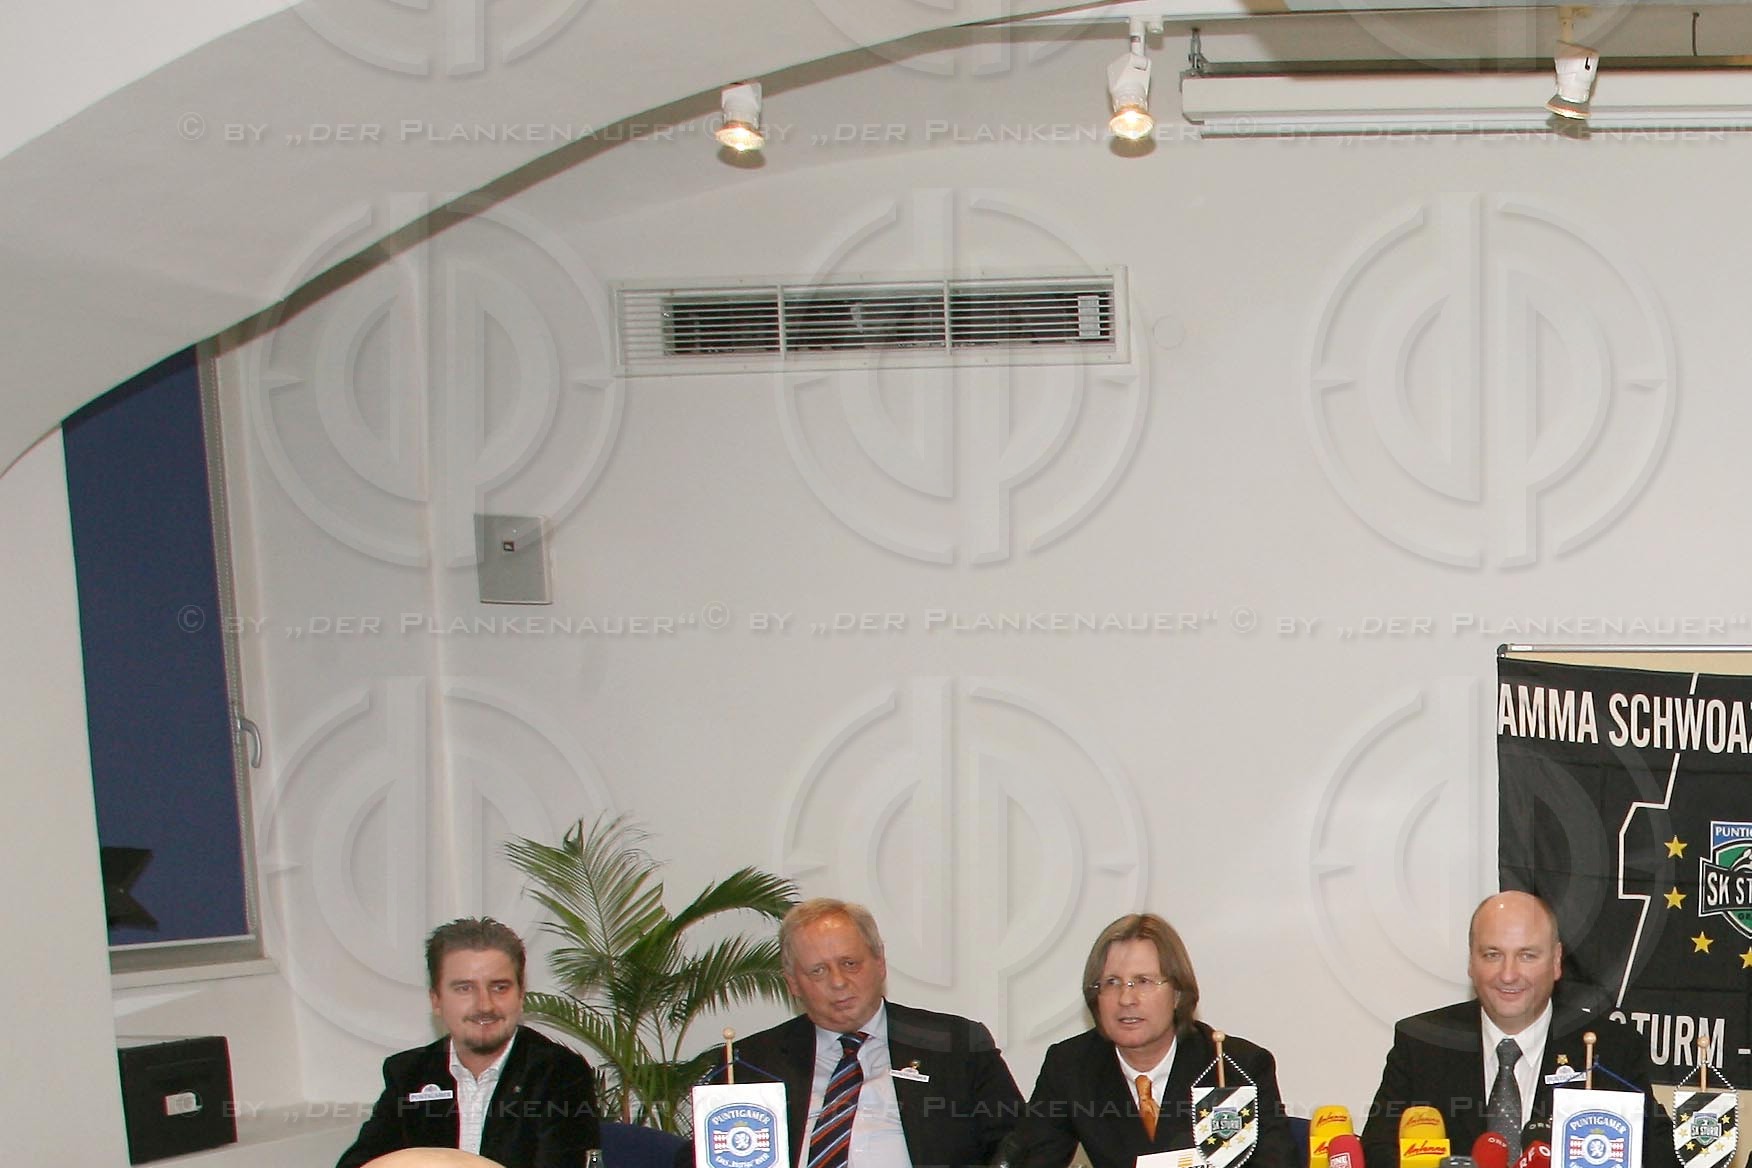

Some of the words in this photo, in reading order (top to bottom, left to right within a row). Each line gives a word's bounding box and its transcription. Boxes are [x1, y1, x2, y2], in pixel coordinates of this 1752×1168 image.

[1707, 871, 1730, 906] SK
[711, 1109, 770, 1126] PUNTIGAMER
[1569, 1116, 1627, 1134] PUNTIGAMER
